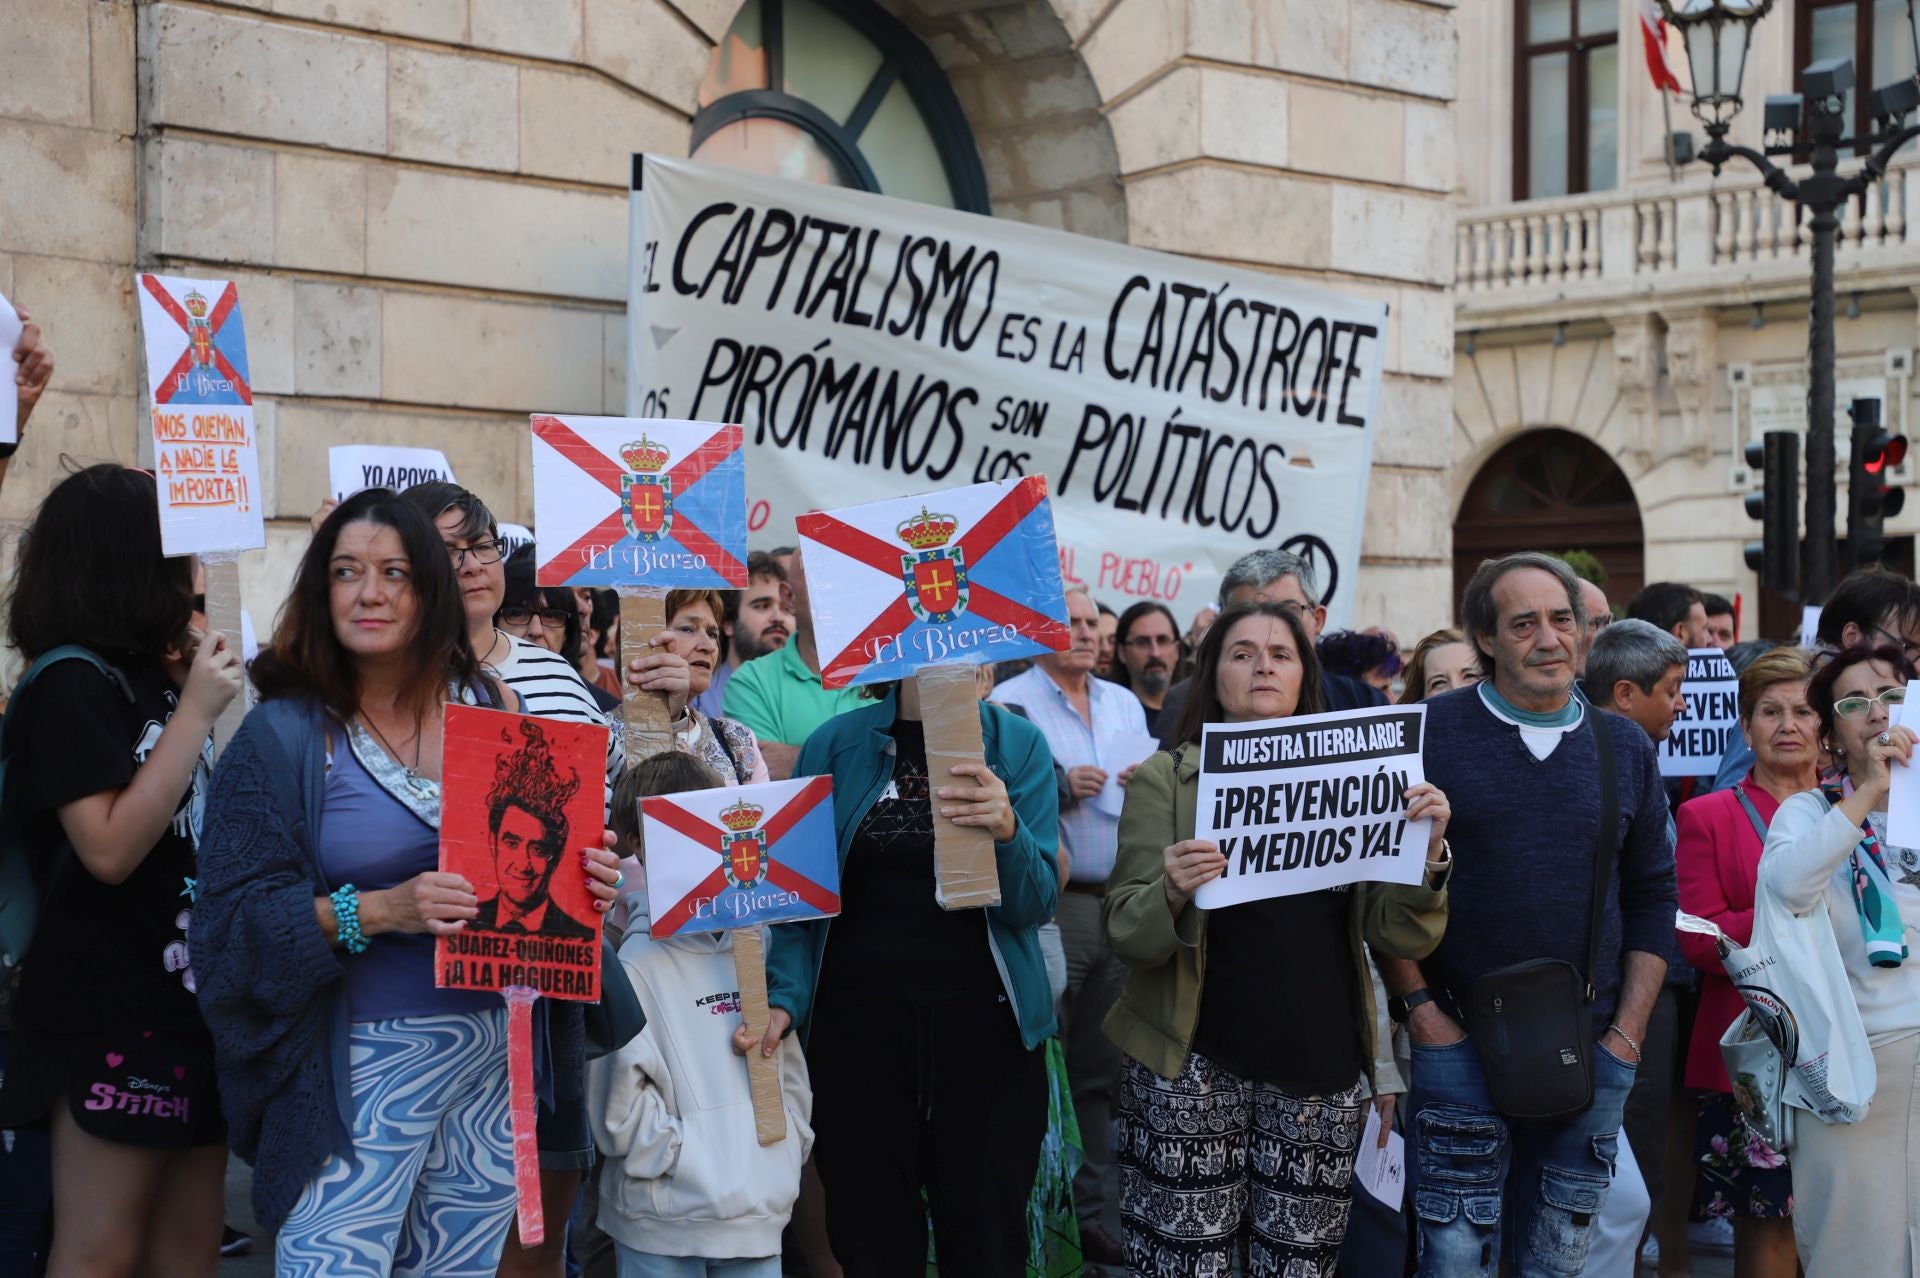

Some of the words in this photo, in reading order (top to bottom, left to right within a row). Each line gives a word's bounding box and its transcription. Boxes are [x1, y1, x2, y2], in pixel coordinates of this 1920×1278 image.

[672, 202, 999, 351] CAPITALISMO
[996, 312, 1042, 363] ES
[1049, 320, 1087, 374] LA
[1104, 275, 1377, 428] CATÁSTROFE
[689, 337, 979, 481] PIRÓMANOS
[991, 396, 1048, 438] SON
[160, 452, 171, 468] A
[221, 449, 238, 468] LE
[362, 465, 382, 487] YO
[387, 467, 437, 489] APOYO
[973, 446, 1030, 484] LOS
[1057, 405, 1285, 539] POLÍTICOS
[582, 544, 614, 570] El
[623, 545, 706, 576] Bierzo
[864, 632, 904, 665] El
[912, 622, 1017, 662] Bierzo
[1222, 734, 1305, 766] NUESTRA
[1307, 726, 1368, 758] TIERRA
[1368, 721, 1405, 746] ARDE
[1212, 765, 1409, 830] ¡PREVENCIÓN
[1219, 837, 1238, 878] Y
[1239, 826, 1356, 876] MEDIOS
[1359, 819, 1406, 860] YA!
[688, 895, 718, 920] El
[725, 890, 800, 919] Bierzo
[470, 961, 493, 987] LA
[499, 963, 593, 996] HOGUERA!
[695, 992, 731, 1007] KEEP
